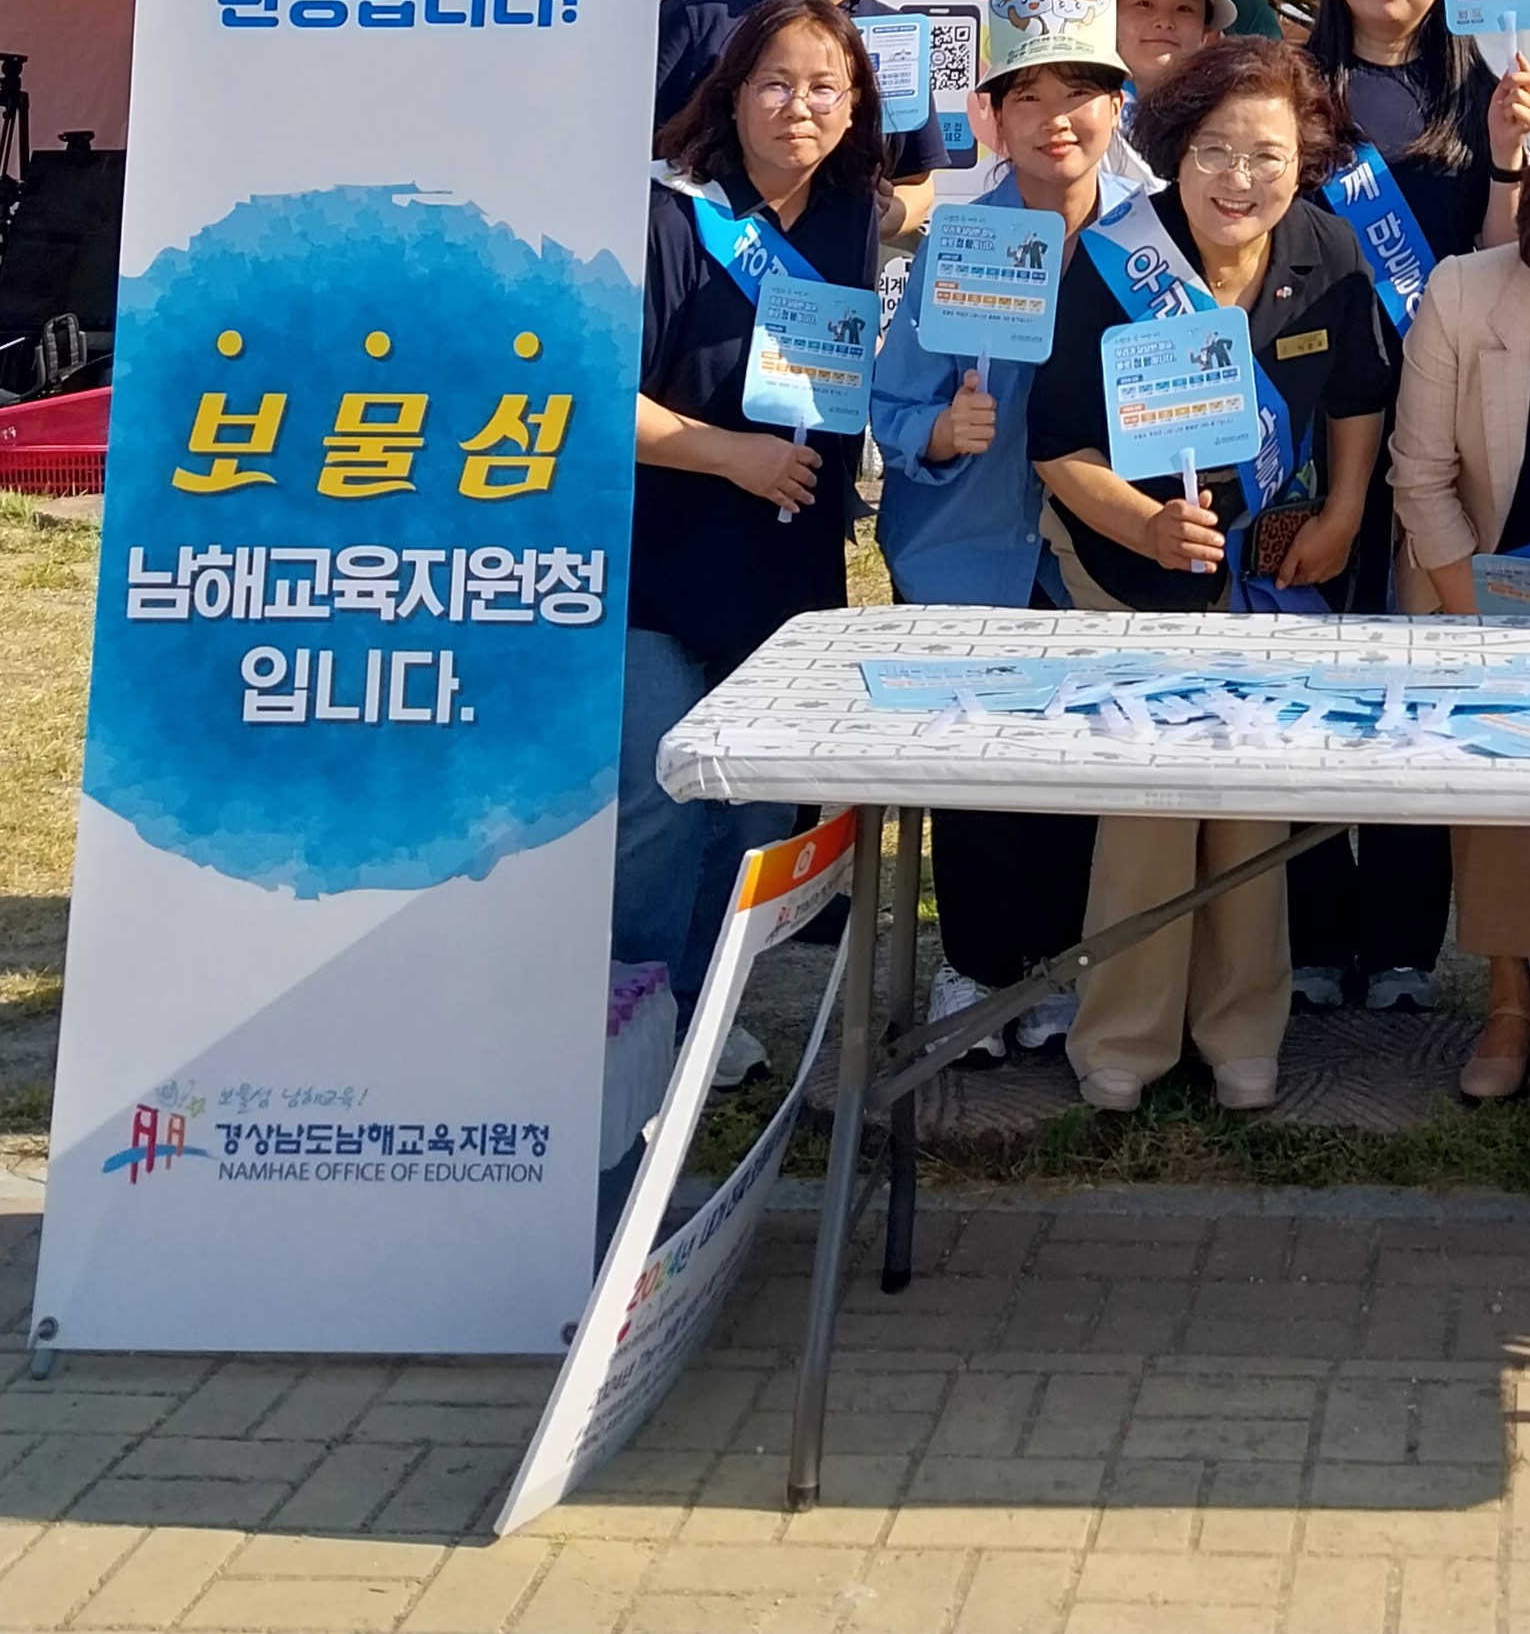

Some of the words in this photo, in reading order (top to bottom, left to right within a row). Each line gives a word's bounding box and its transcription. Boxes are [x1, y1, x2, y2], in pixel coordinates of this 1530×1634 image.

[126, 544, 605, 625] 남해교육지원청
[240, 645, 475, 724] 입니다.
[215, 1121, 550, 1157] 경상남도남해교육지원청
[218, 1161, 311, 1182] NAMHAE
[315, 1161, 386, 1183] OFFICE
[390, 1162, 420, 1183] OF
[424, 1162, 544, 1183] EDUCATION
